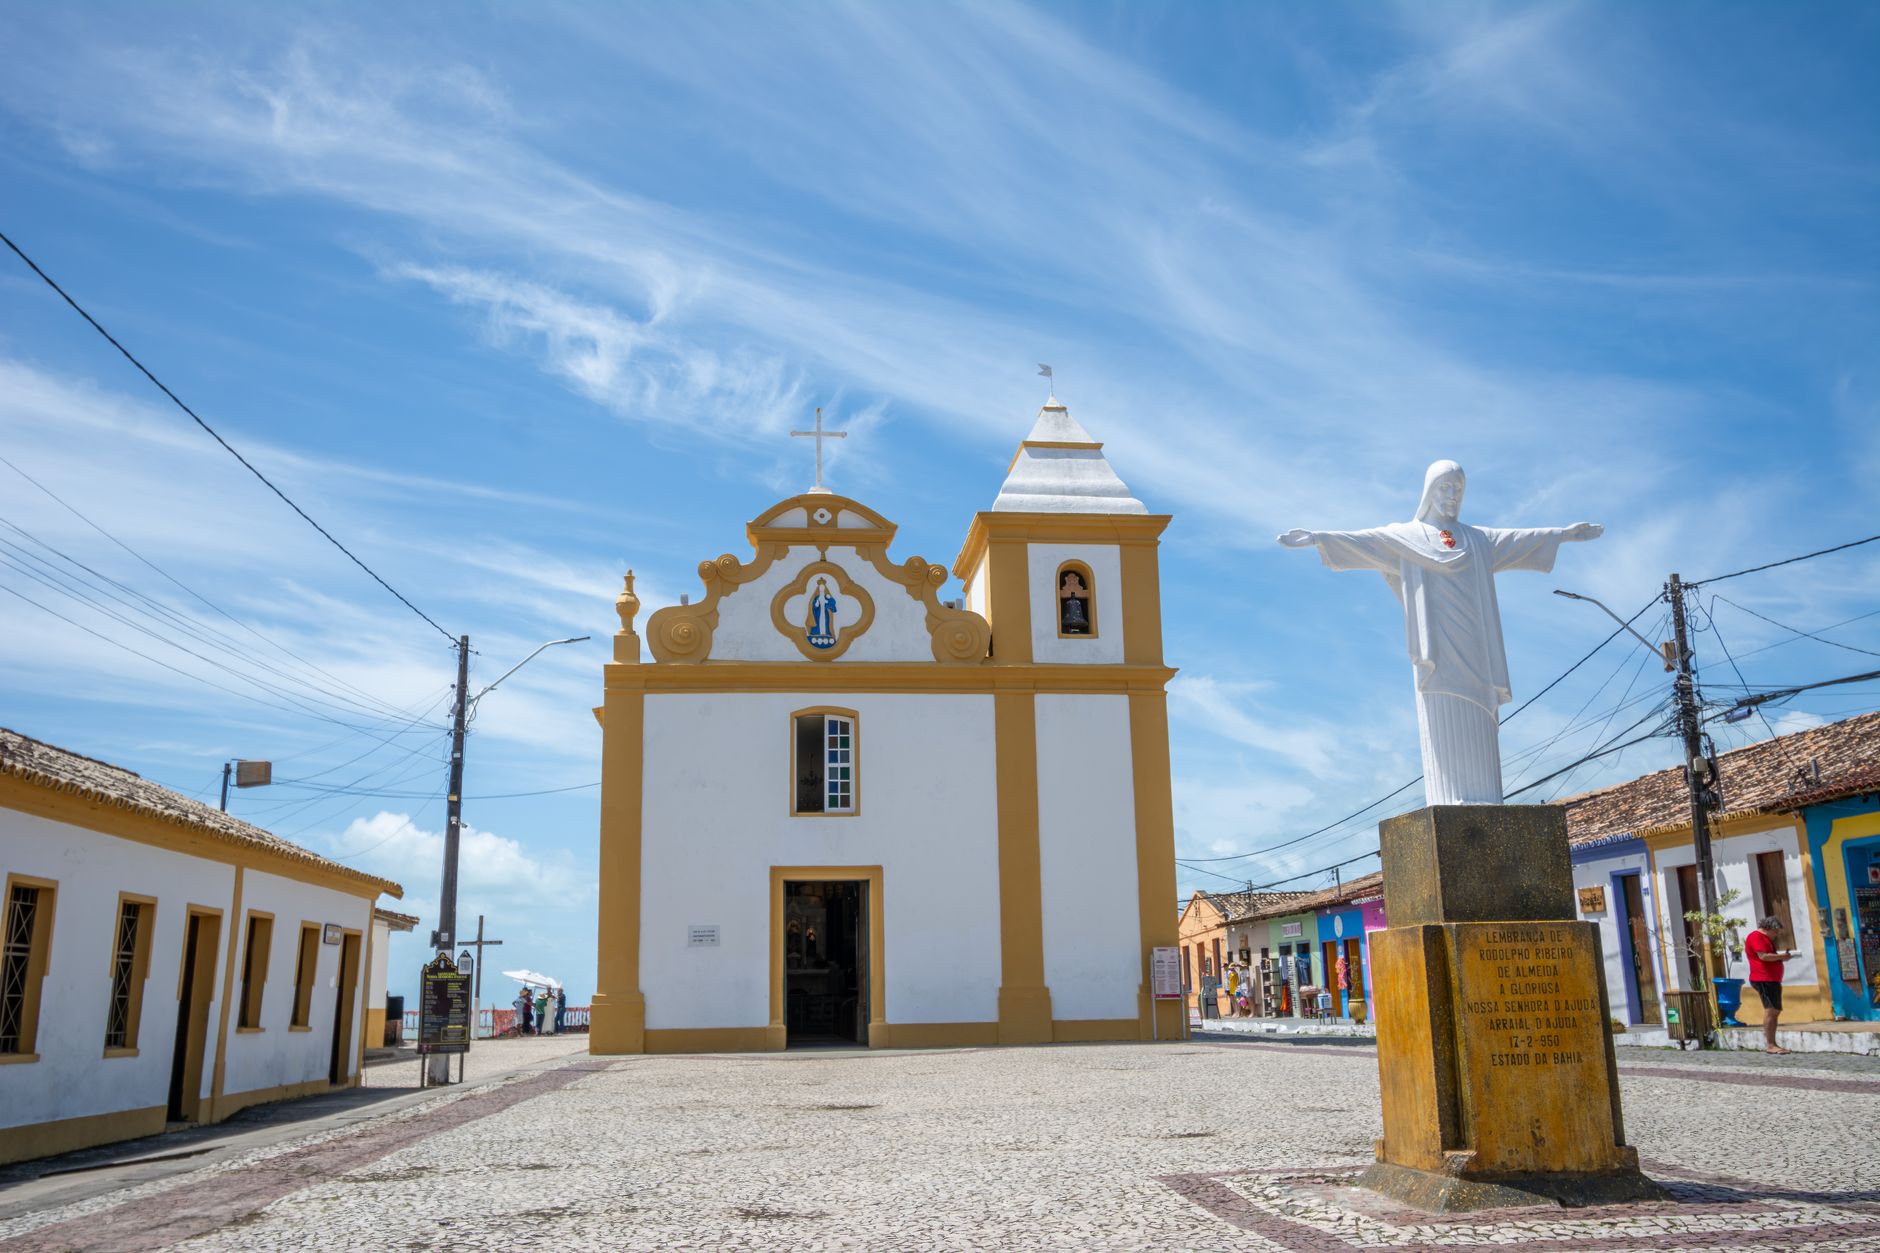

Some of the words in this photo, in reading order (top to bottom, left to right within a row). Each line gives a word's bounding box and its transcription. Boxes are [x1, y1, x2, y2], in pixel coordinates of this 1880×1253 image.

[1550, 930, 1563, 942] DE
[1480, 948, 1530, 960] RODOLPHO
[1535, 947, 1573, 960] RIBEIRO
[1497, 966, 1510, 978] DE
[1516, 965, 1559, 978] ALMEIDA
[1500, 983, 1505, 995] A
[1511, 982, 1560, 995] GLORIOSA
[1467, 1001, 1499, 1014] NOSSA
[1505, 1000, 1549, 1013] SENHORA
[1489, 1018, 1530, 1031] ARRAIAL
[1491, 1053, 1530, 1067] ESTADO
[1535, 1053, 1548, 1065] DA
[1553, 1052, 1584, 1065] BAHIA
